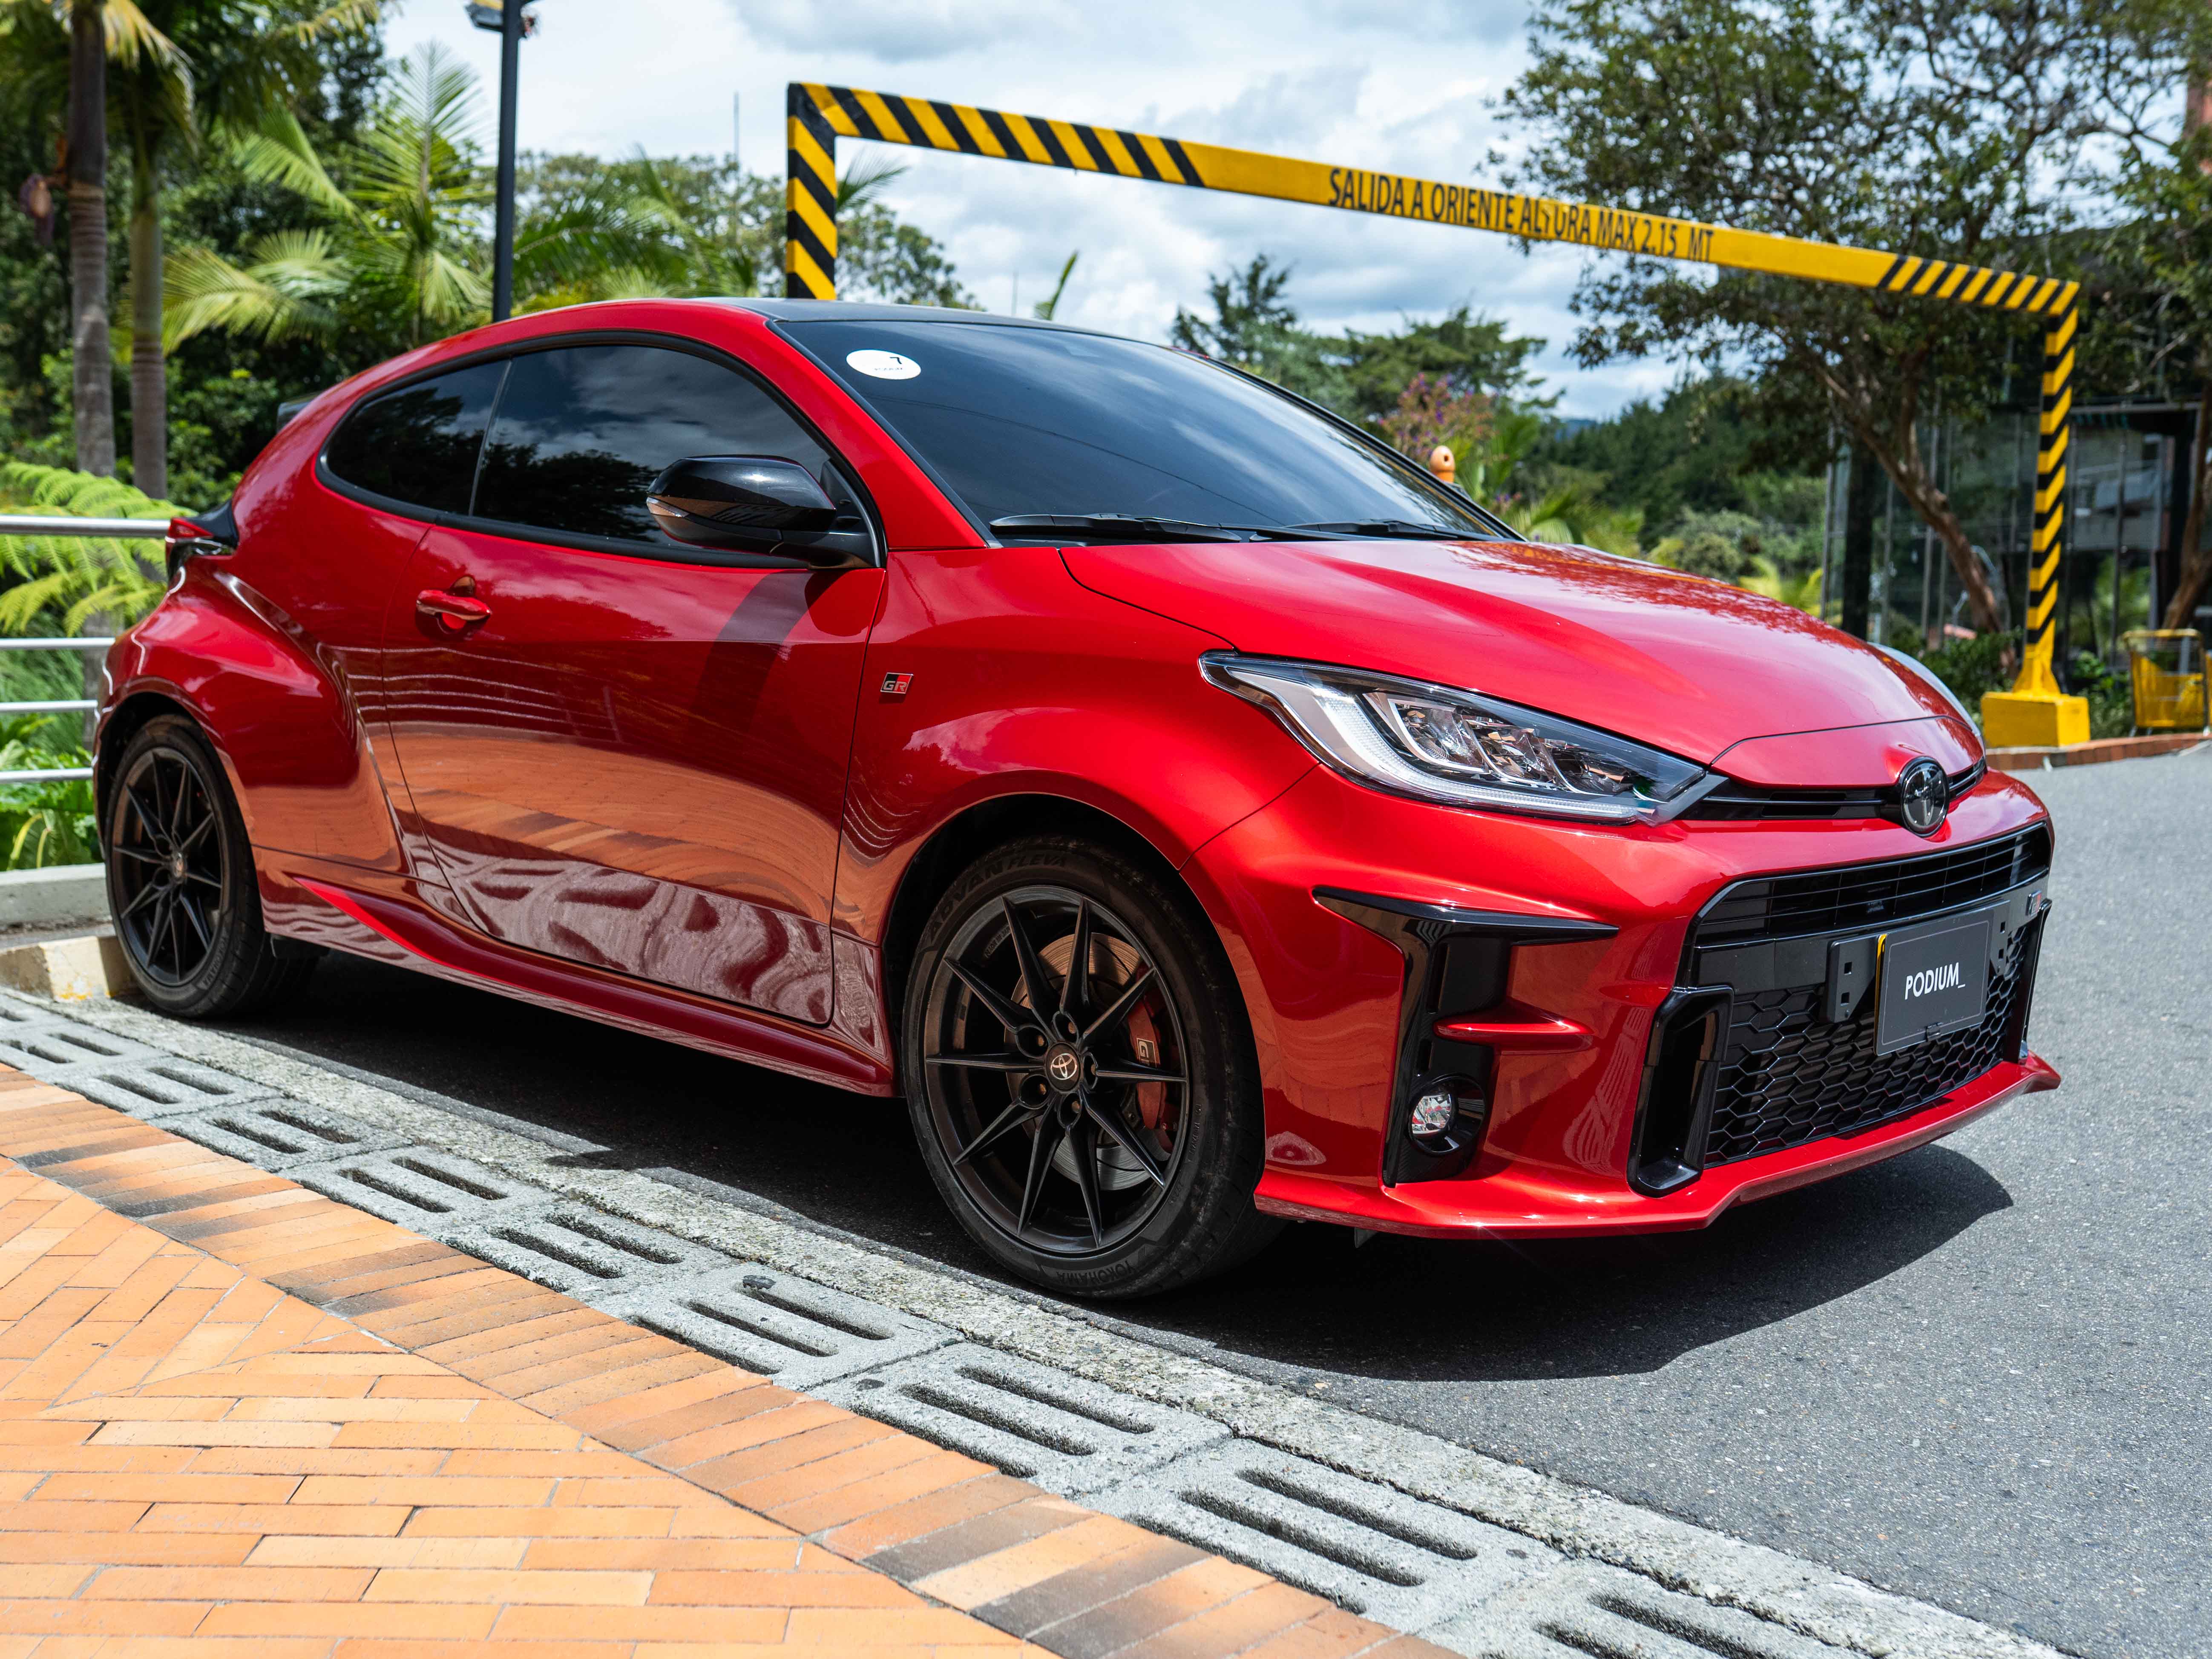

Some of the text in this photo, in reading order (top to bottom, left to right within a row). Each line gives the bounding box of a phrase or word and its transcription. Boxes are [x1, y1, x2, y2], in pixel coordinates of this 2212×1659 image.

[1329, 168, 1404, 216] SALIDA
[1411, 181, 1423, 218] A
[1432, 183, 1515, 229] ORIENTE
[1596, 210, 1638, 252] MAX
[1641, 219, 1679, 256] 2.15
[1688, 227, 1714, 262] MT
[883, 680, 907, 692] GR
[930, 860, 1004, 943] ADVAN
[1056, 1260, 1135, 1285] YOKOHAMA
